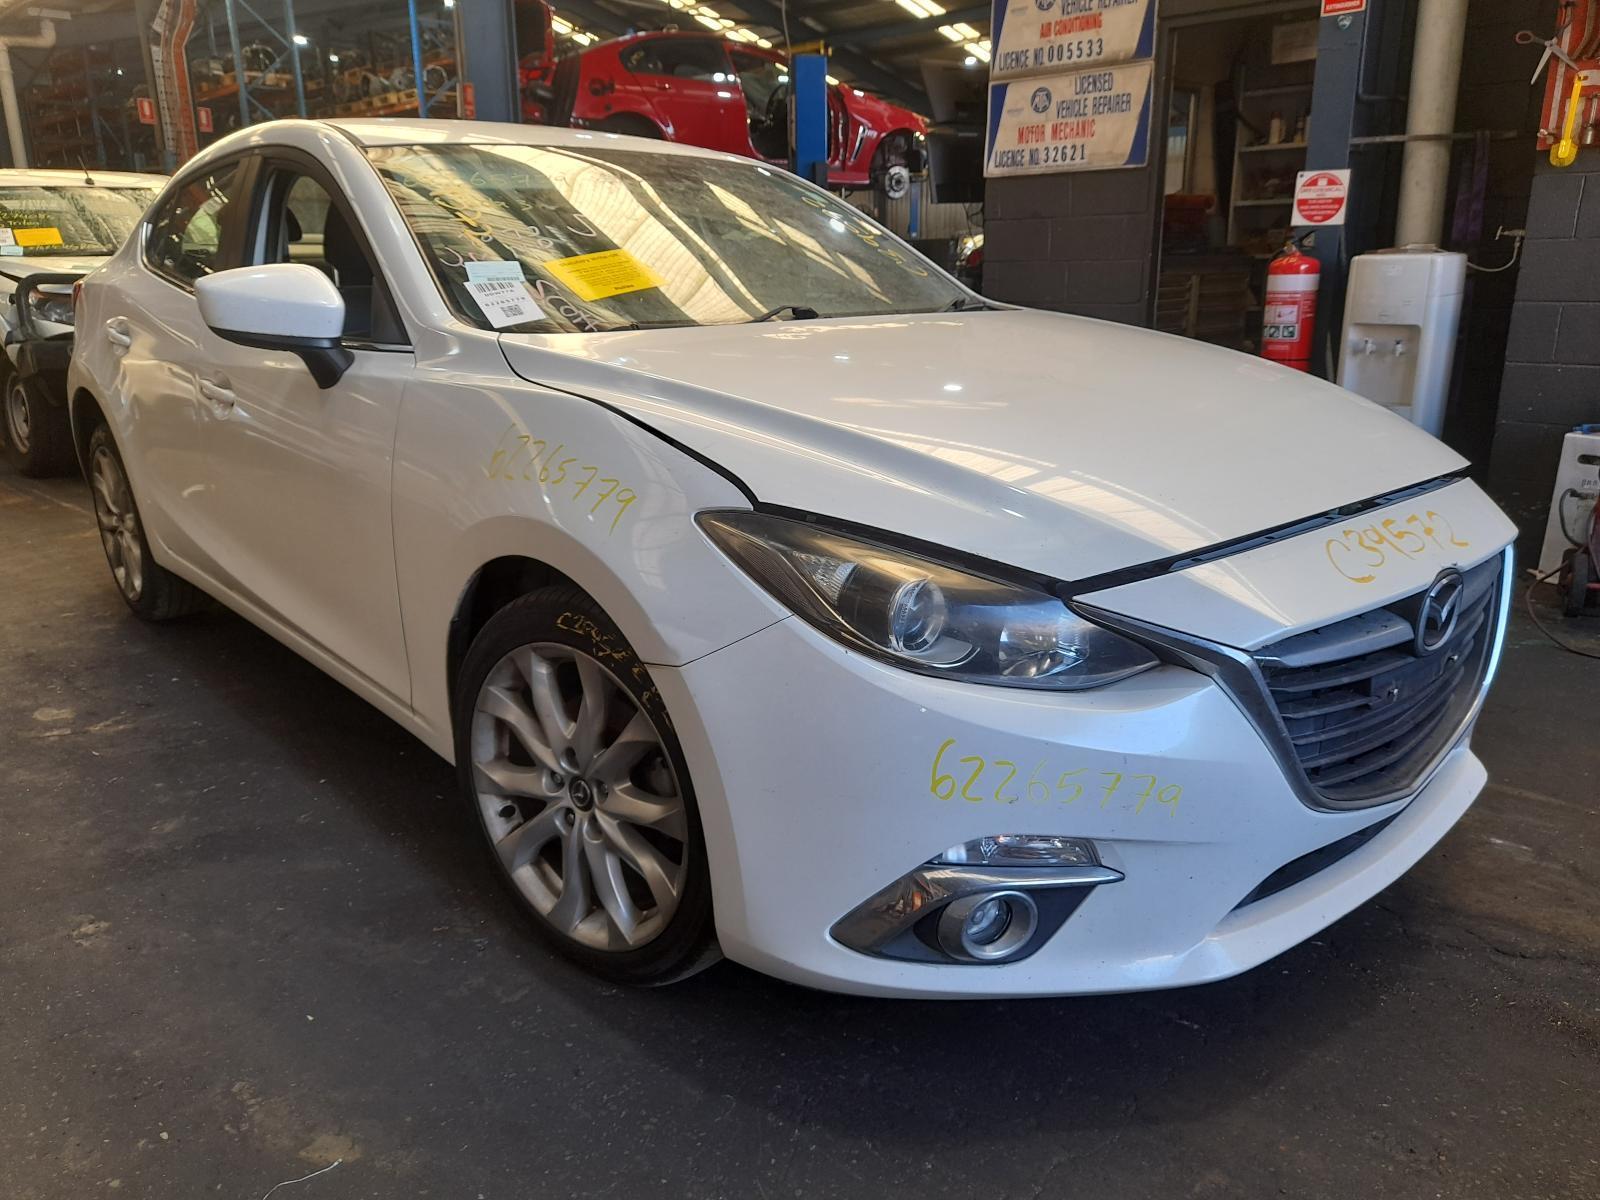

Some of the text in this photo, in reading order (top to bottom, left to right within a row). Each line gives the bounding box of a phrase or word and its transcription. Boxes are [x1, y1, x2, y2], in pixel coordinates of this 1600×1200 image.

[1040, 12, 1103, 38] AIR CONDITIONING
[999, 48, 1029, 71] LICENCE
[1047, 38, 1103, 62] 005533
[1074, 72, 1113, 95] LICENSED
[1056, 93, 1131, 119] VEHICLE REPAIRER
[1018, 118, 1096, 144] MOTOR MECHANIC
[995, 148, 1025, 168] LICENCE
[1043, 144, 1085, 163] 32621
[488, 422, 638, 536] 62265779
[1325, 510, 1470, 584] C39572
[930, 737, 1184, 818] 62265779
